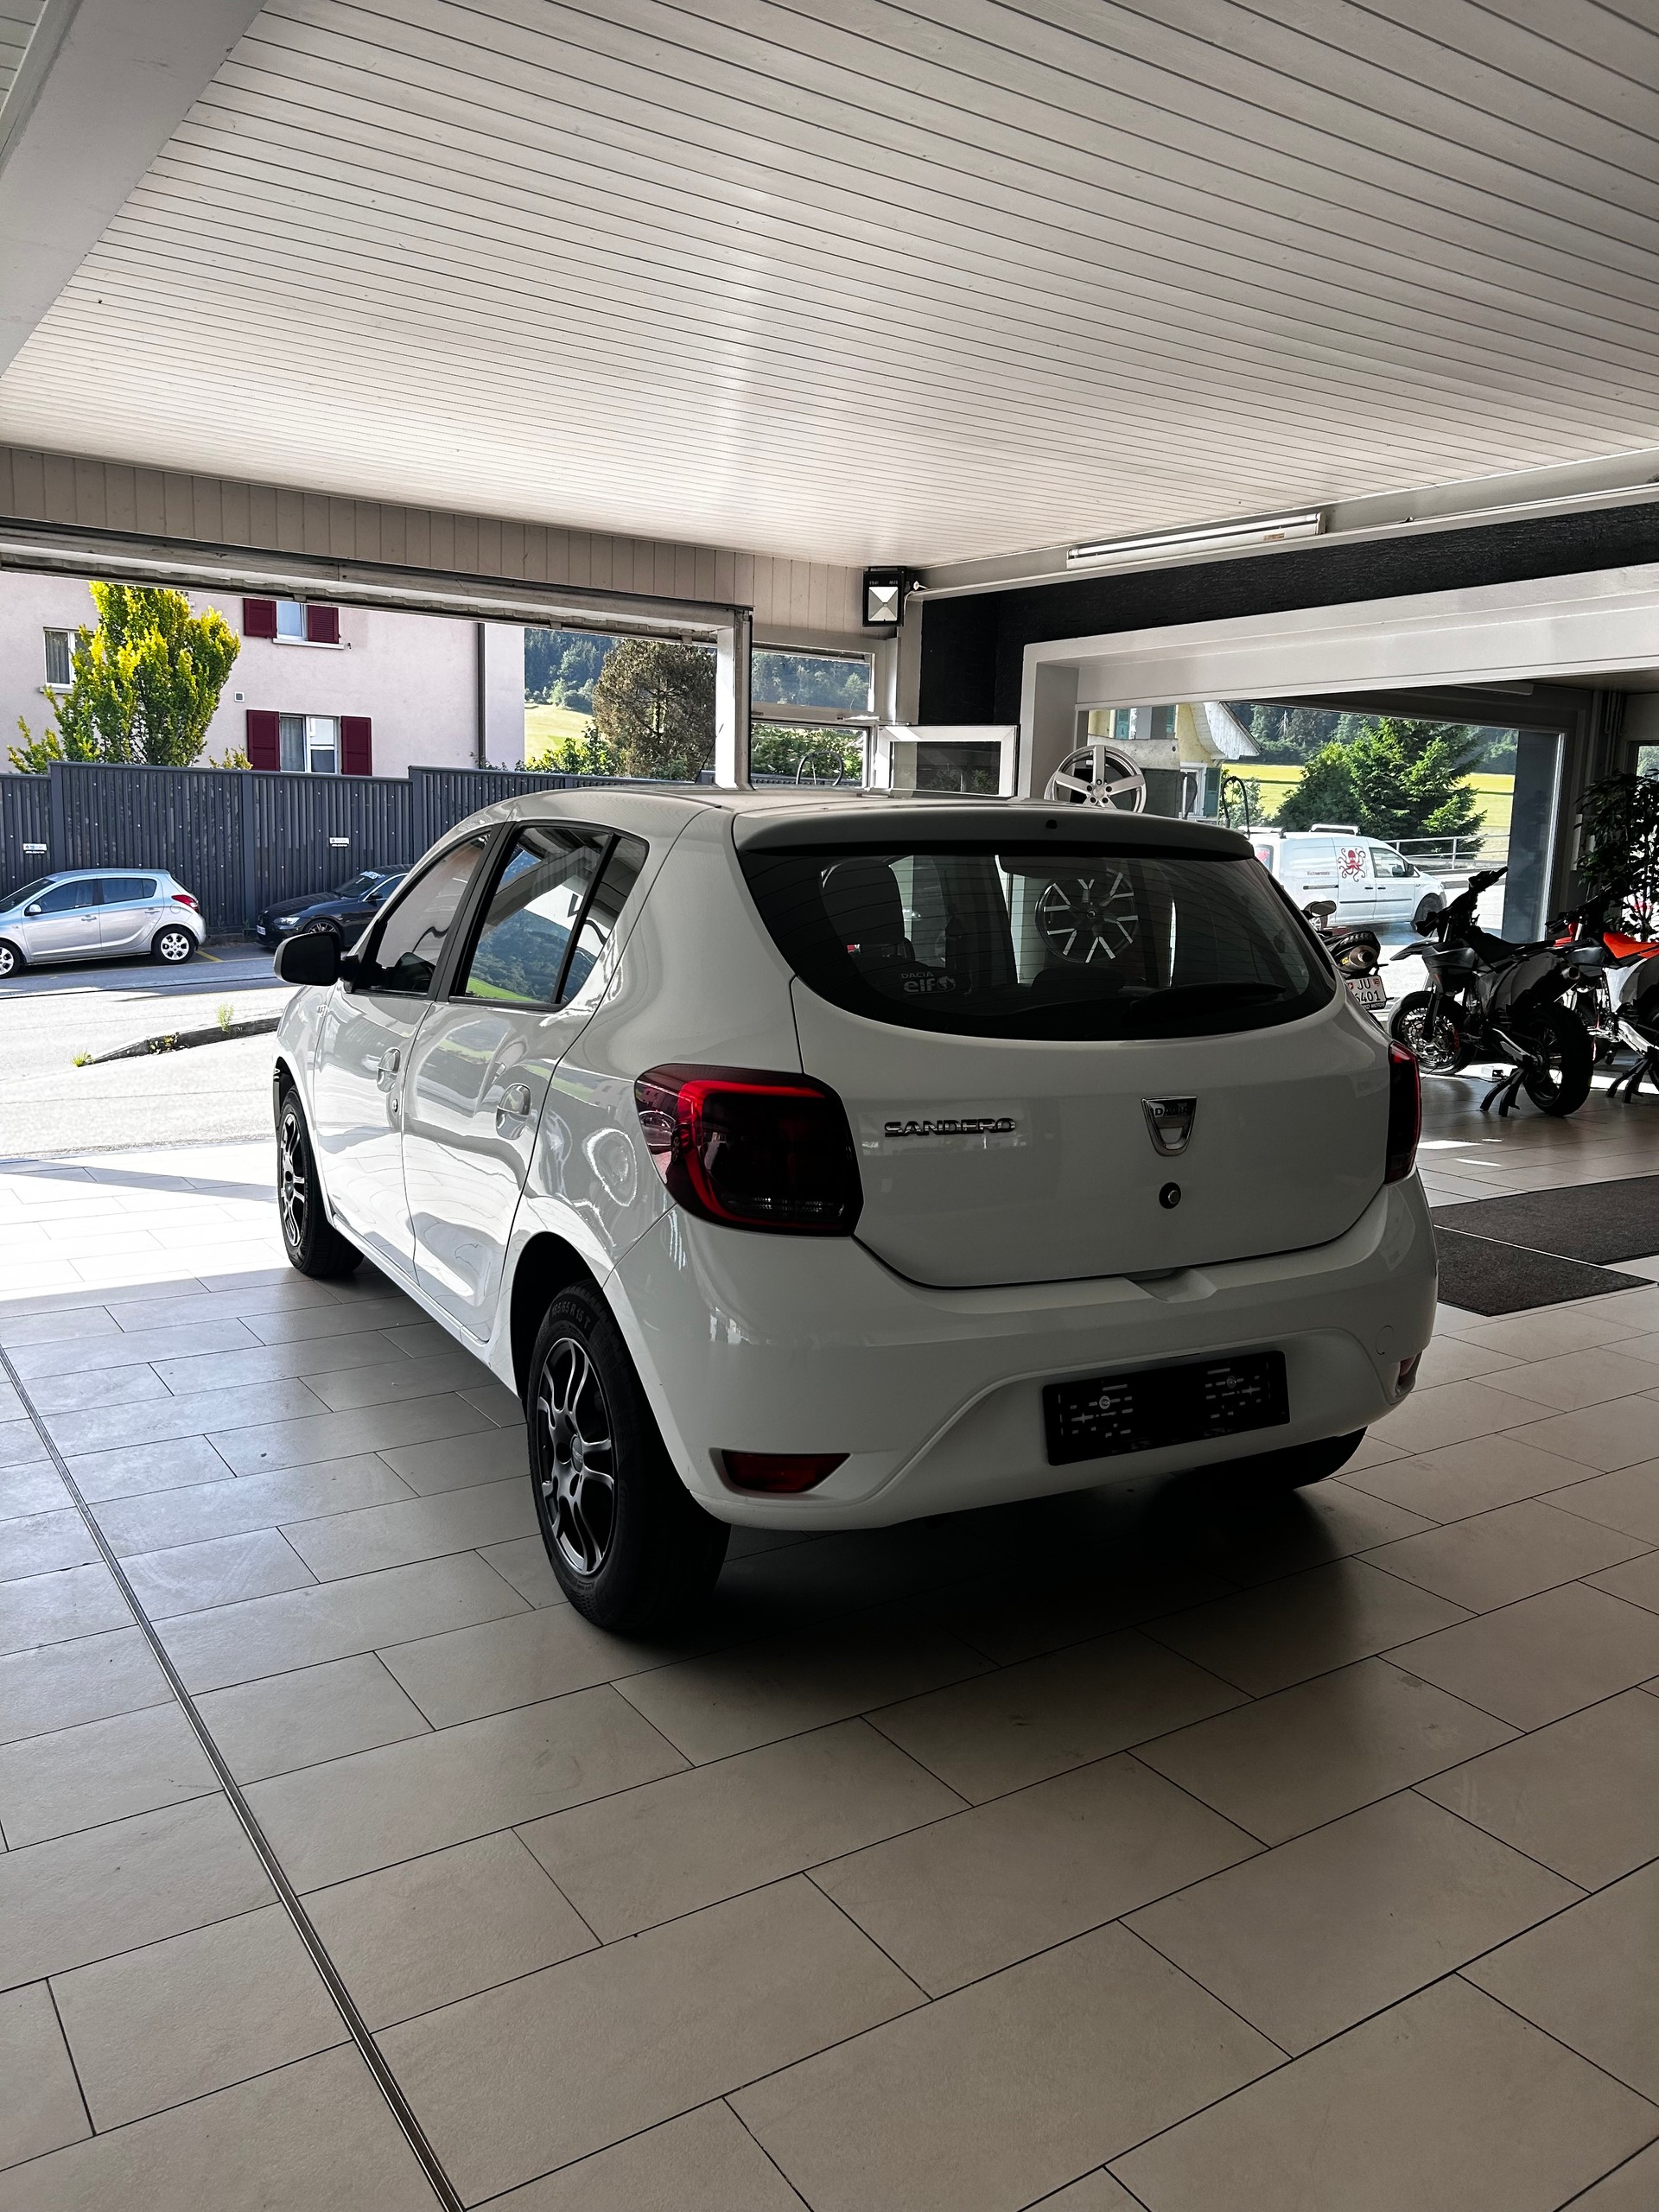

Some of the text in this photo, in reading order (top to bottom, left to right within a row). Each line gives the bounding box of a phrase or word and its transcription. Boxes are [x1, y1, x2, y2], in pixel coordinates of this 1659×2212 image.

[900, 971, 934, 980] DACIA
[903, 978, 936, 993] elf
[1357, 978, 1370, 990] JU
[1155, 1105, 1190, 1116] DACIA
[885, 1118, 1016, 1137] SANDERO
